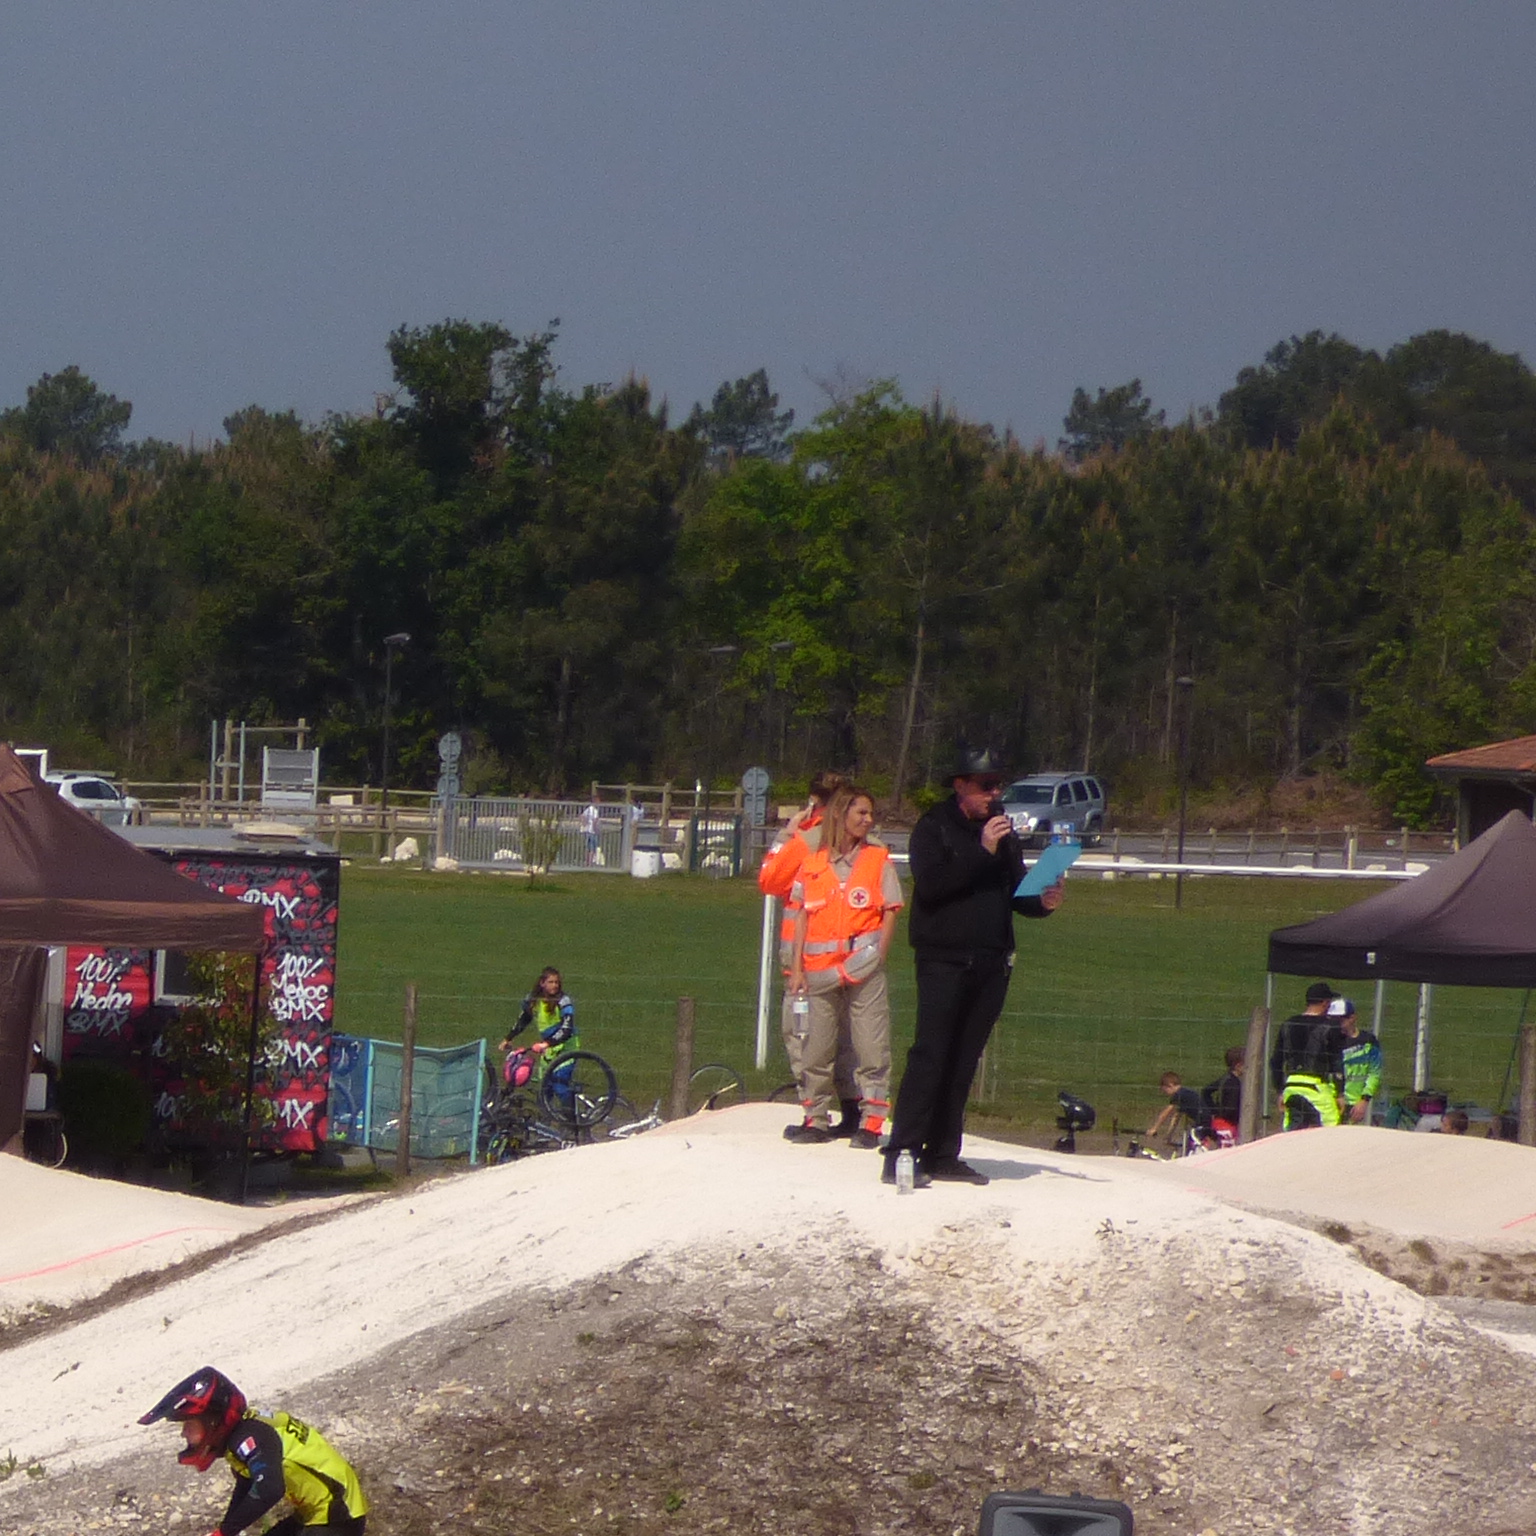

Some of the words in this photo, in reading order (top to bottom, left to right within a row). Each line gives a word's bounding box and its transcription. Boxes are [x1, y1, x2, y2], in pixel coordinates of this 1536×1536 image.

[277, 952, 324, 979] 100%
[70, 981, 133, 1012] Medoc
[269, 971, 329, 1001] Medoc
[268, 998, 325, 1022] BMX
